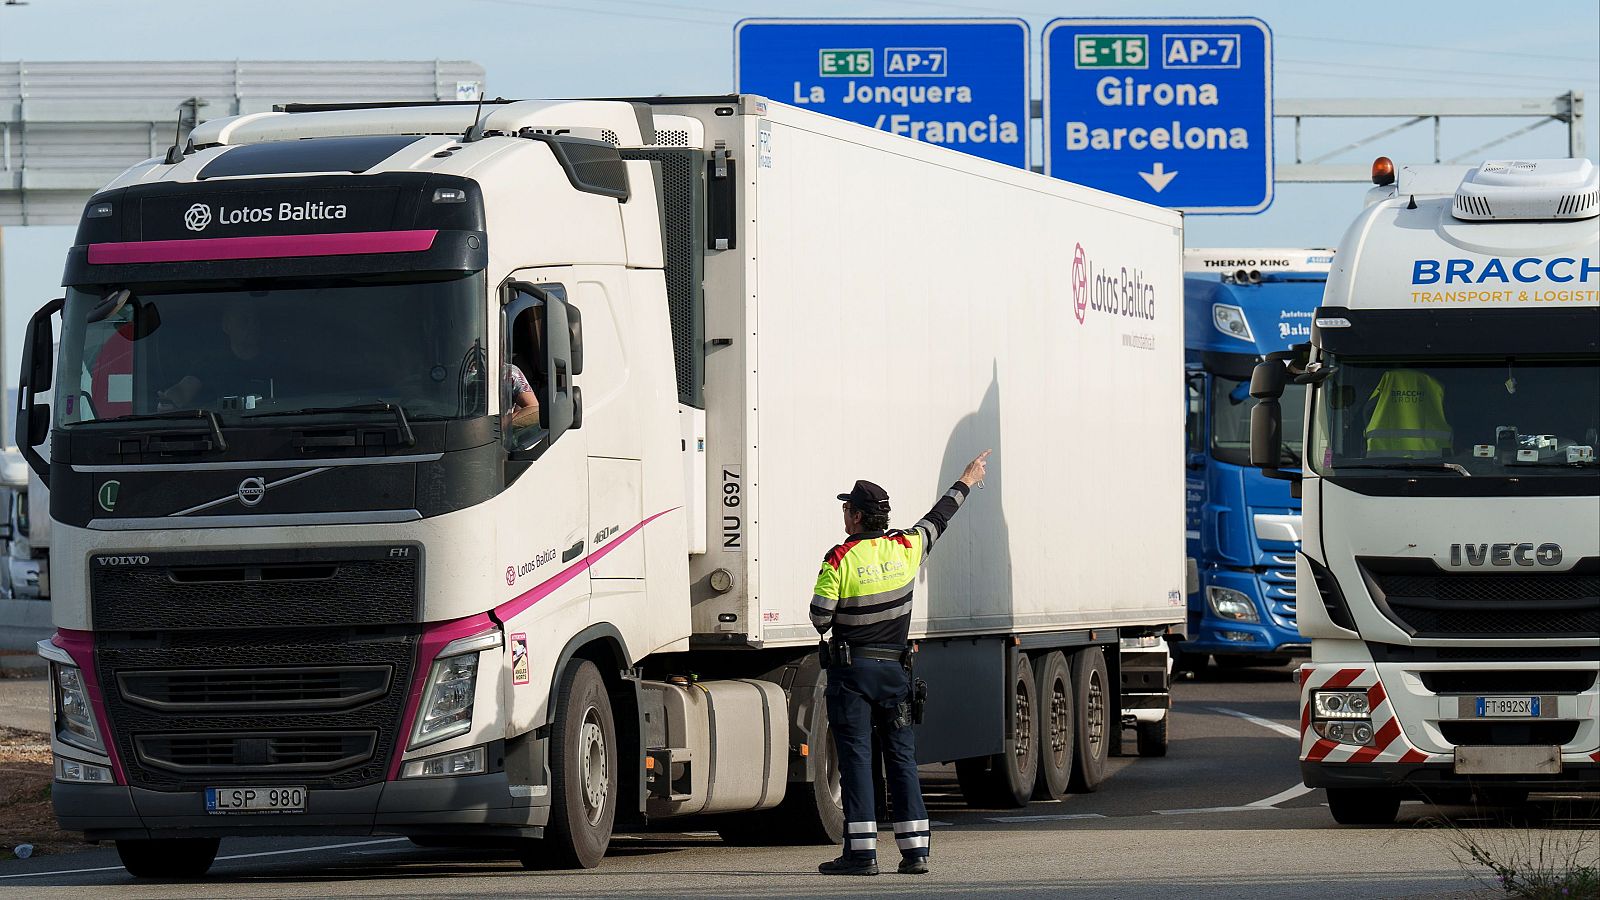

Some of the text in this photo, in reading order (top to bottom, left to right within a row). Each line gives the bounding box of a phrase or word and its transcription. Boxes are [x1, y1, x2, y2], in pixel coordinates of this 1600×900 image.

[822, 53, 942, 72] E-15 AP-7
[1079, 39, 1235, 64] E-15 AP-7
[793, 81, 972, 107] La Jonquera
[1096, 76, 1219, 106] Girona
[1066, 121, 1249, 151] Barcelona
[219, 201, 347, 225] Lotos Baltica
[1204, 259, 1256, 267] THERMO
[1090, 260, 1155, 321] Lotos Baltica
[1411, 290, 1513, 303] TRANSPORT
[1518, 290, 1528, 301] &
[723, 469, 741, 548] NU 697
[593, 527, 609, 545] 460
[97, 555, 150, 566] VOLVO
[389, 547, 409, 557] FH
[517, 548, 557, 578] Lotos Baltica
[1450, 543, 1563, 566] IVECO
[218, 790, 302, 808] LSP 980
